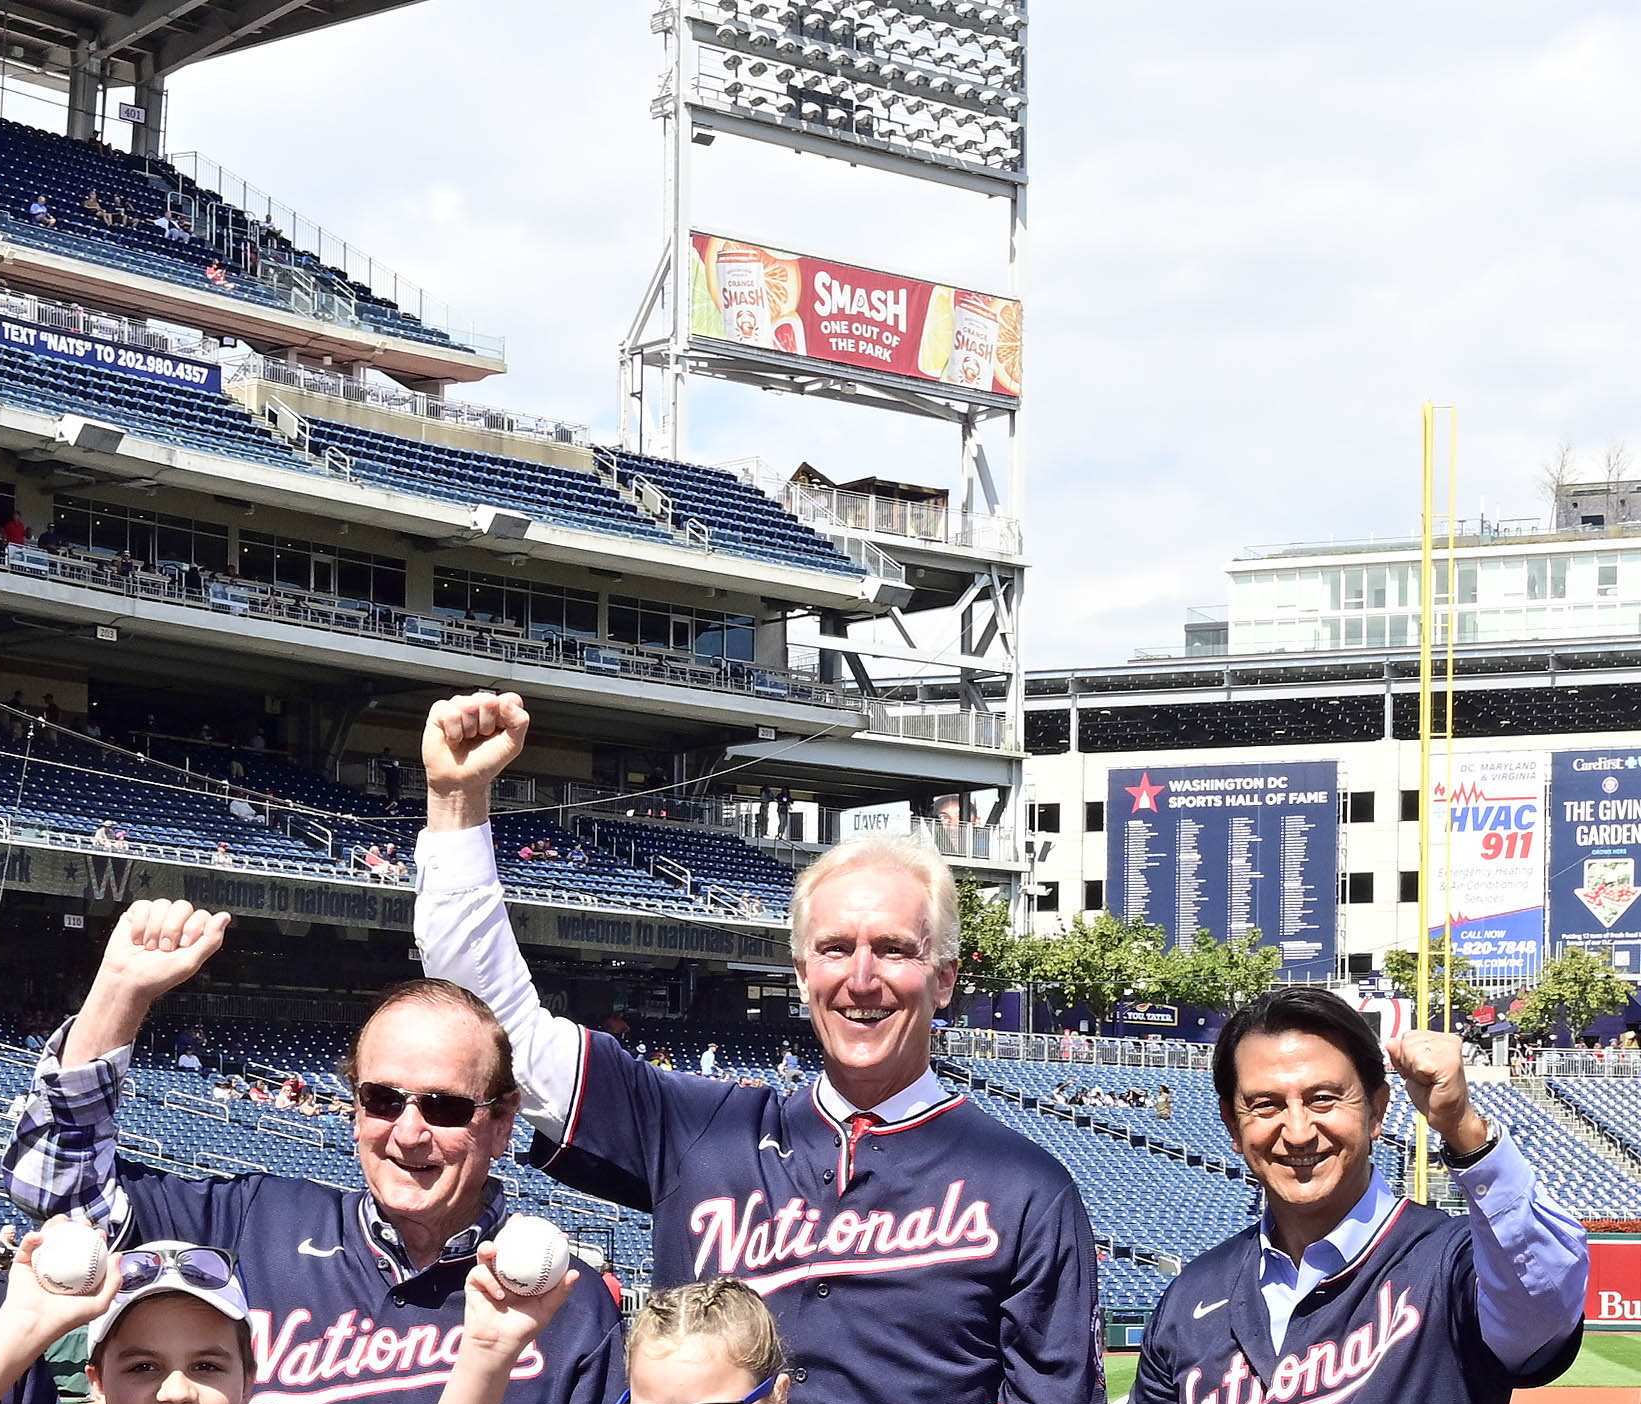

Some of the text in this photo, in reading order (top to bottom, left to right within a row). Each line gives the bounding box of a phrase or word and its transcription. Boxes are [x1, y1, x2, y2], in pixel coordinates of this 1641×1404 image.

[124, 108, 141, 120] 401
[721, 287, 765, 309] SMASH
[814, 271, 907, 333] SMASH
[820, 320, 901, 348] ONE OUT OF
[953, 330, 994, 362] SMASH
[1, 322, 37, 347] TEXT
[95, 343, 116, 365] TO
[117, 347, 210, 386] 202.980.4357
[829, 337, 893, 363] THE PARK
[1480, 762, 1537, 772] MARYLAND
[1489, 772, 1537, 782] VIRGINIA
[1169, 776, 1289, 793] WASHINGTON DC
[1168, 791, 1329, 809] SPORTS HALL OF FAME
[1563, 800, 1595, 822] THE
[854, 812, 890, 831] DAVEY
[1445, 804, 1537, 833] HVAC
[1480, 831, 1534, 860] 911
[1438, 867, 1491, 880] Eergency
[184, 873, 265, 910] welcome
[269, 879, 290, 912] to
[294, 883, 379, 921] nationals
[557, 912, 632, 946] welcome
[635, 916, 654, 948] to
[658, 922, 735, 955] nationals
[1461, 929, 1507, 939] CALL NOW
[690, 1180, 1001, 1299] Nationals
